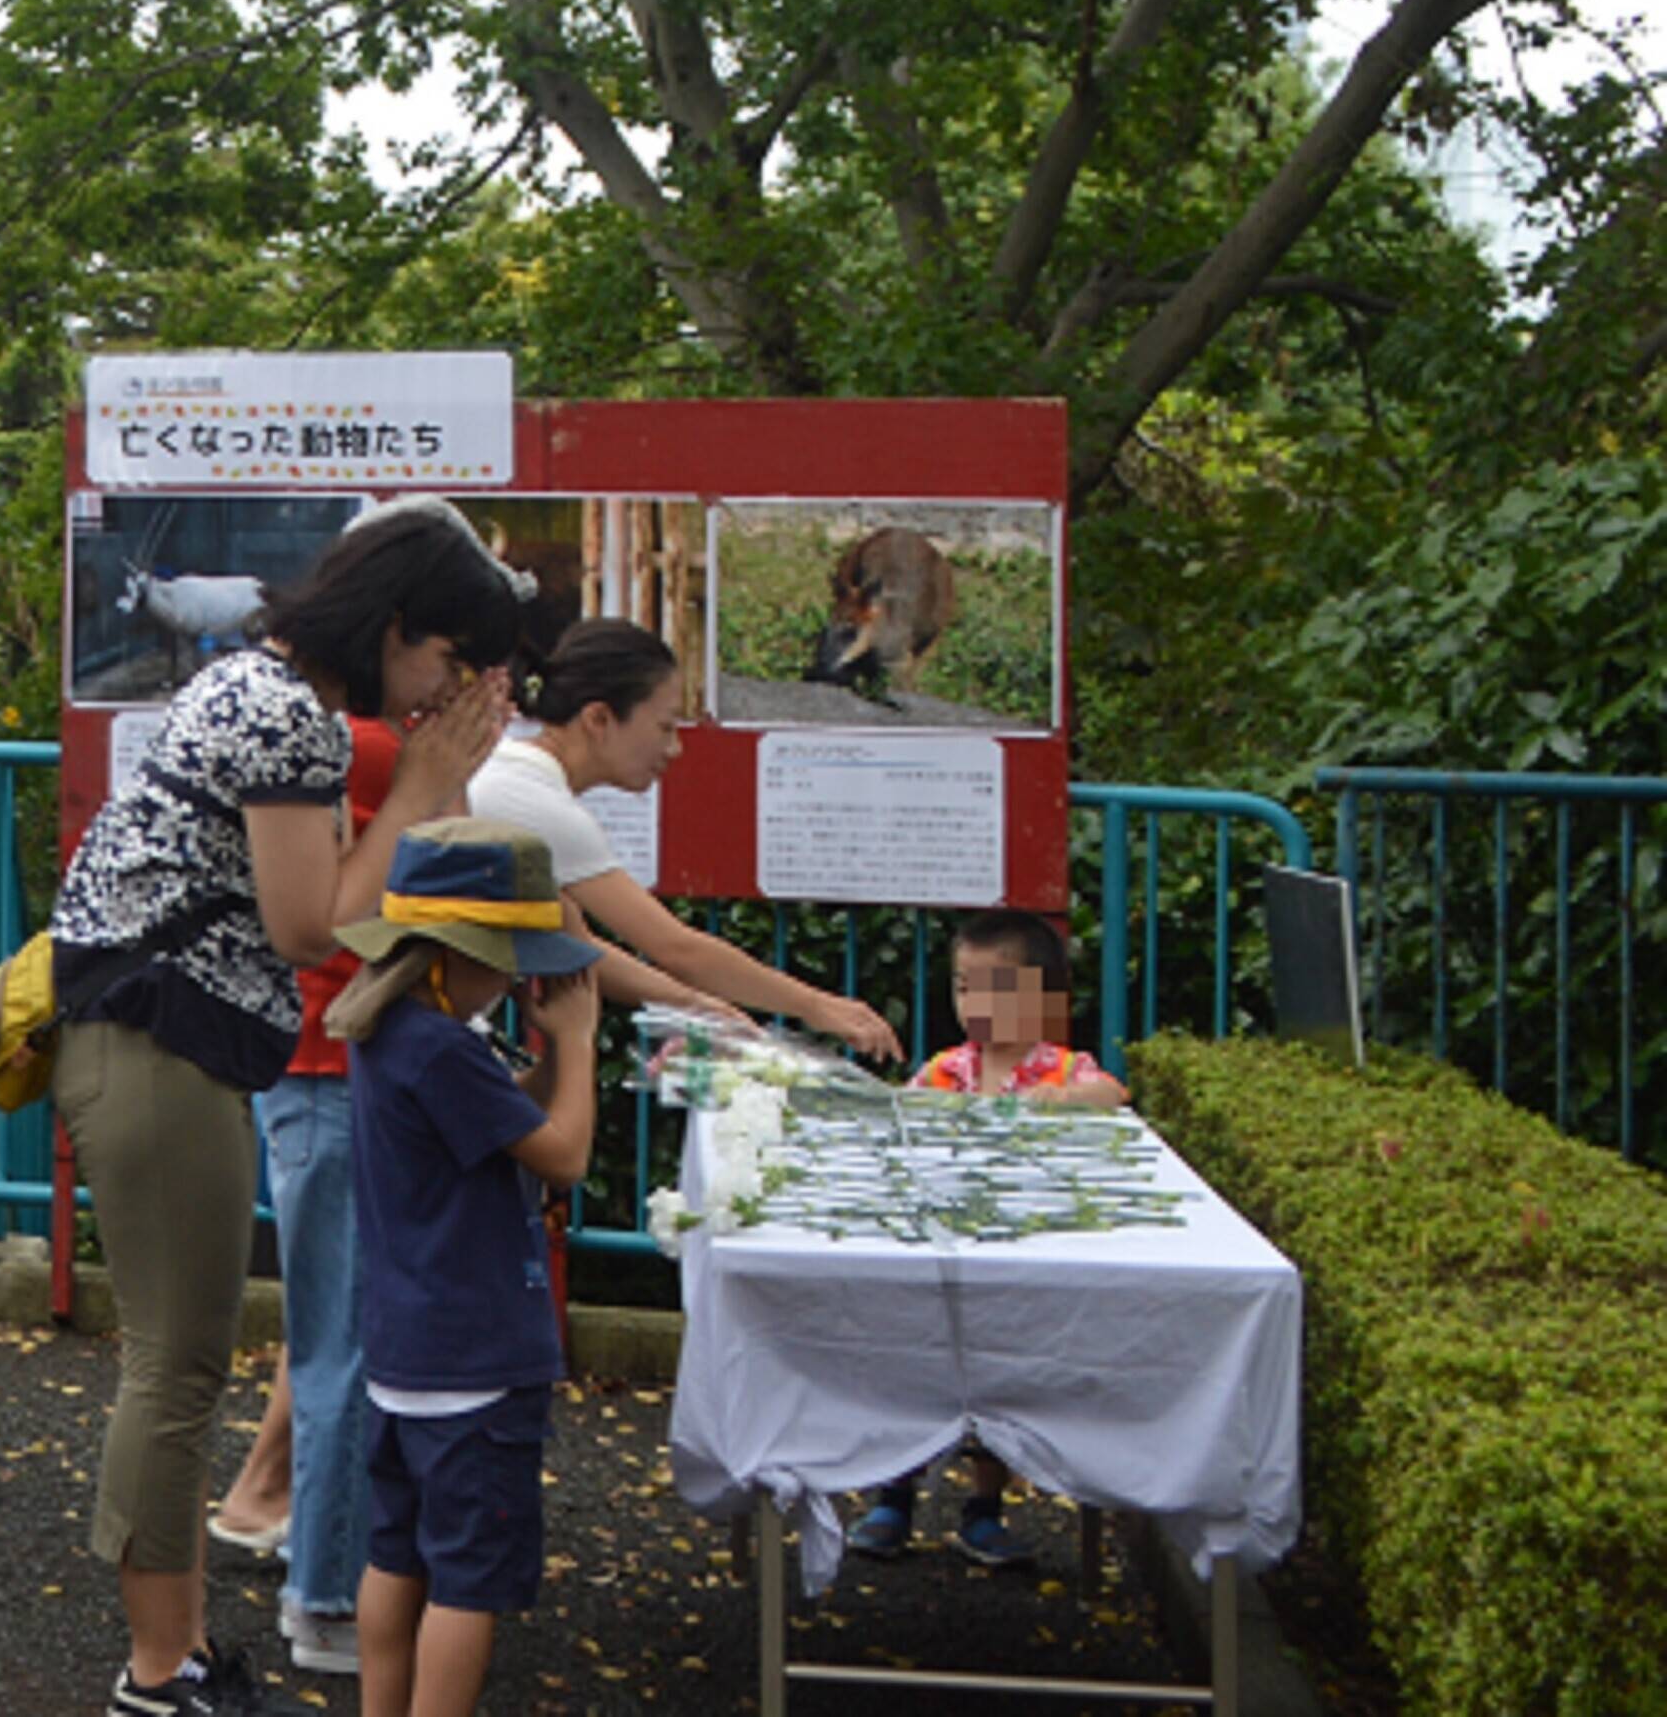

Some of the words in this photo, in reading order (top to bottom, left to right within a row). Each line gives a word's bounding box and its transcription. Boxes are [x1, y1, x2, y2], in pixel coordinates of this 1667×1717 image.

[120, 422, 443, 458] 亡くなった動物たち
